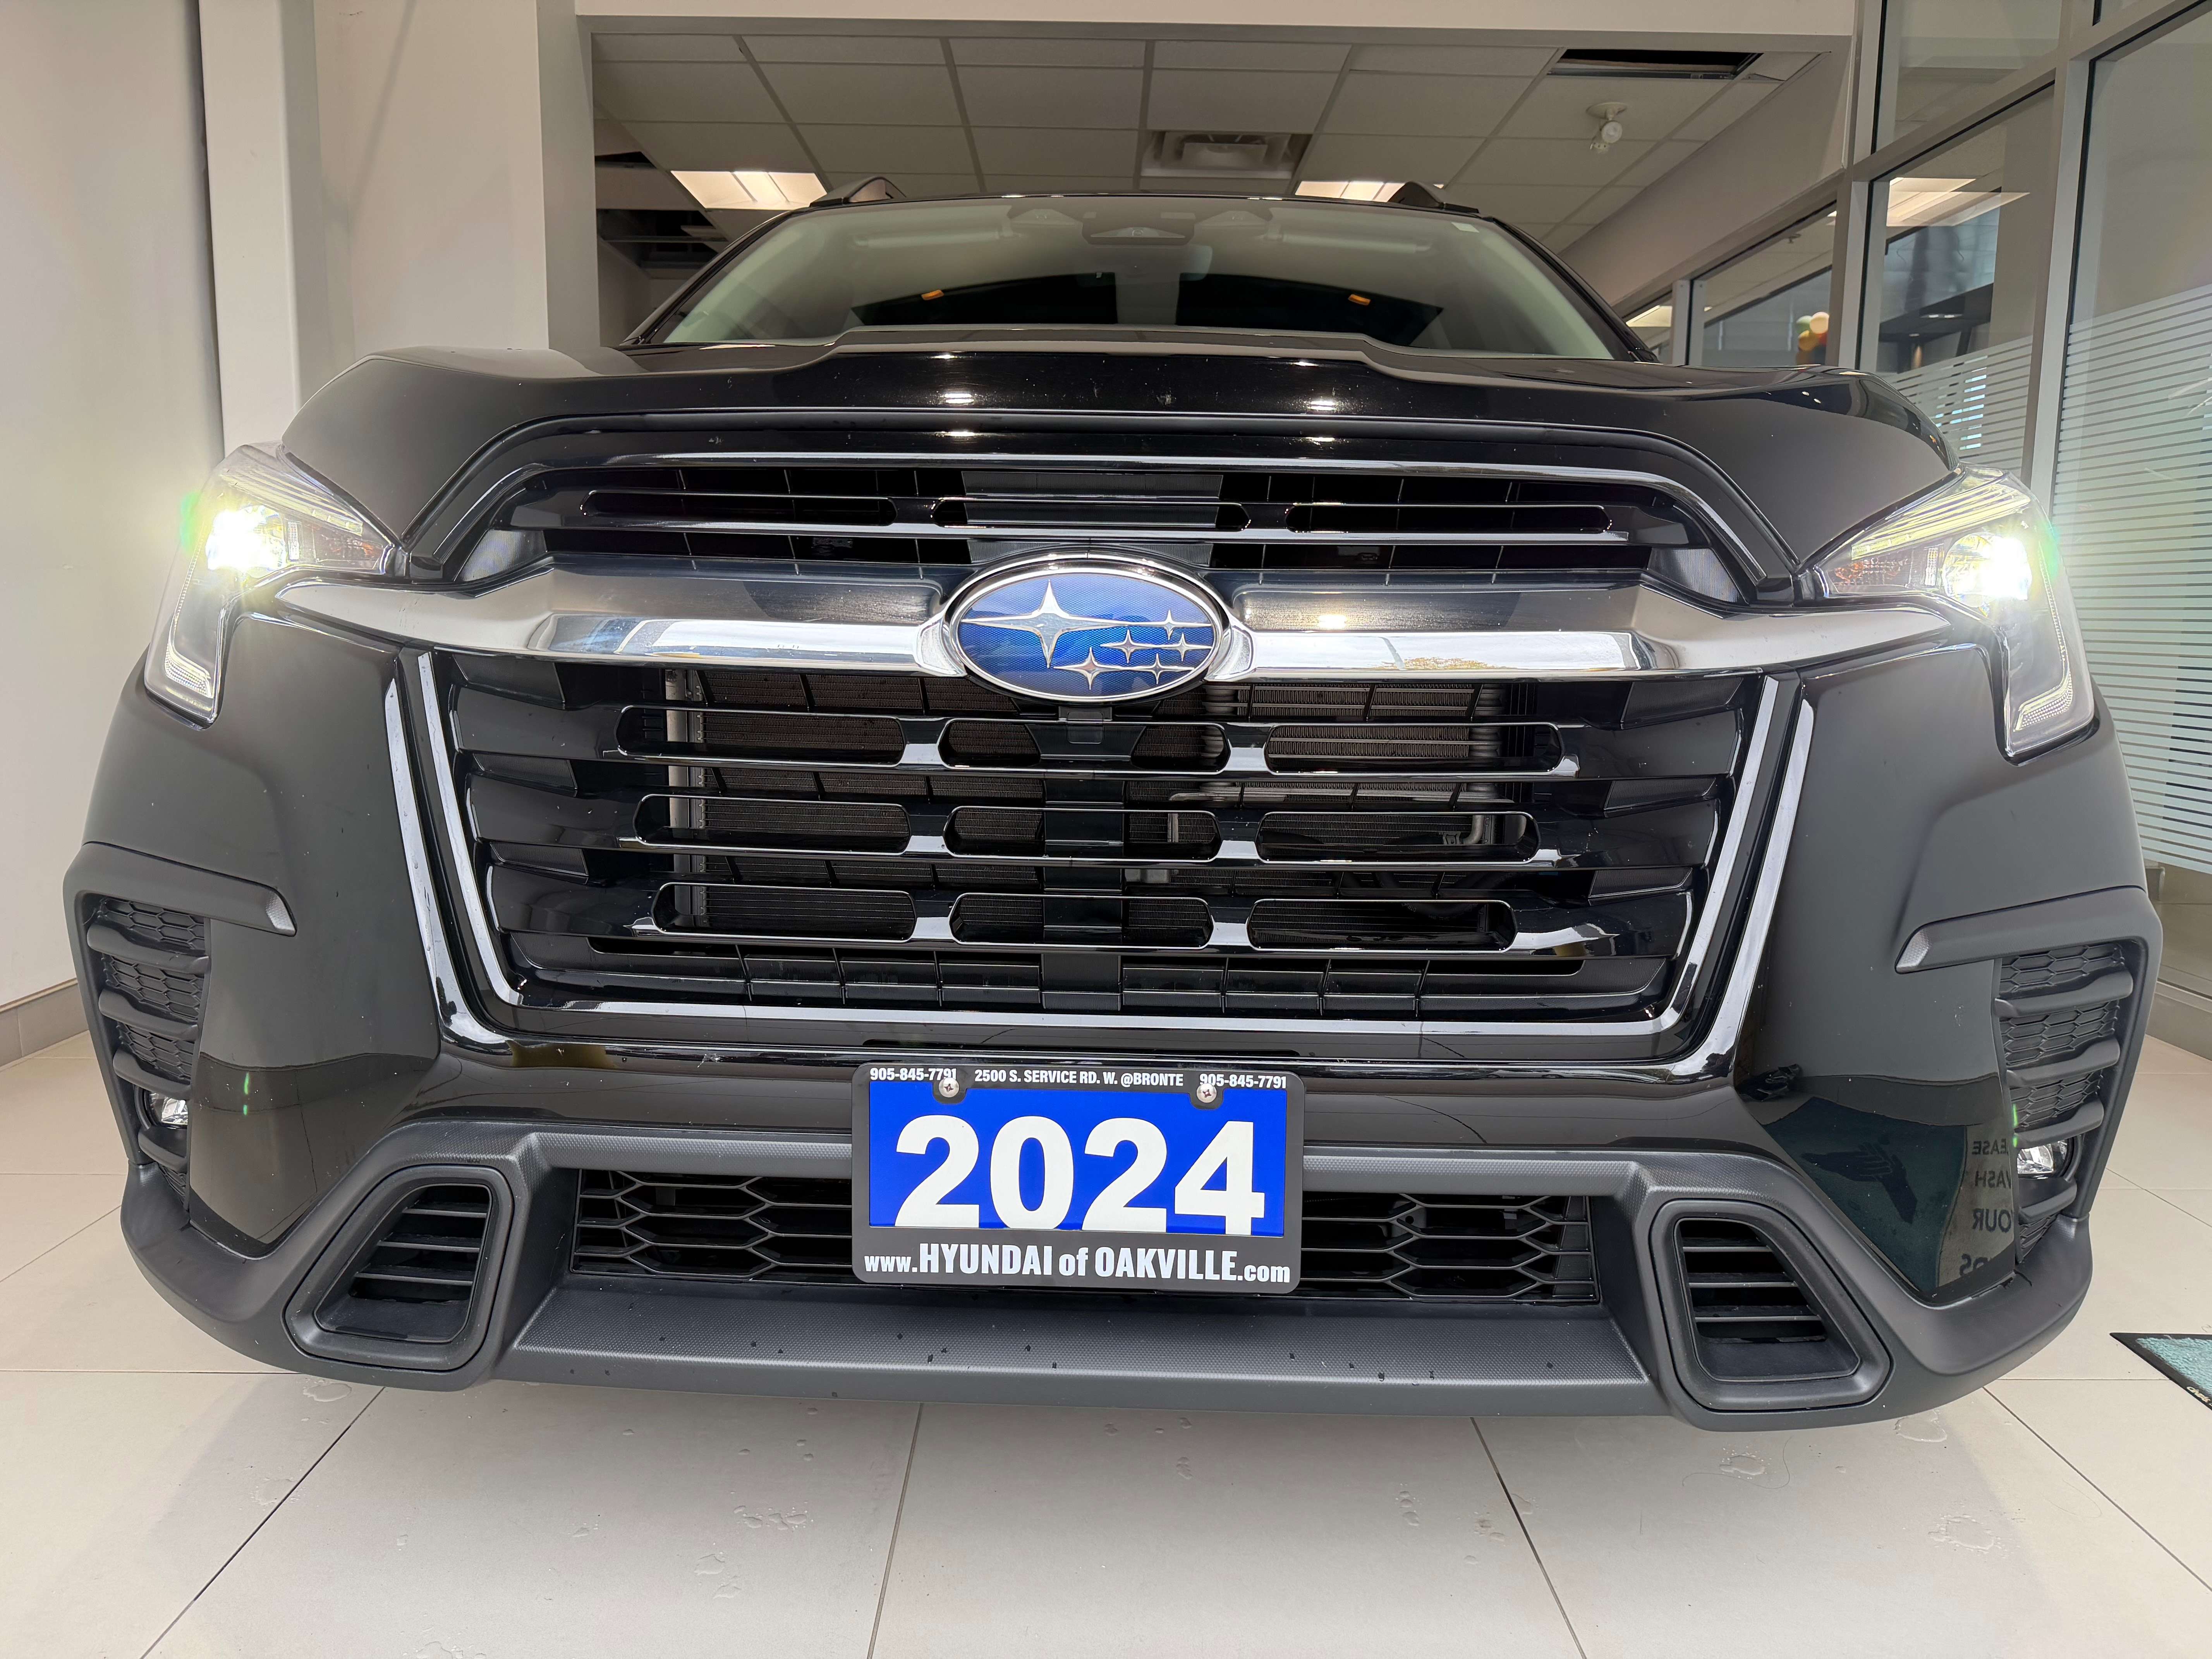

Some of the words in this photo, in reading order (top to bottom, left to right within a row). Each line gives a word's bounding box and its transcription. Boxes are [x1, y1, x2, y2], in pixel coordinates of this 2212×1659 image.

[870, 1067, 957, 1081] 905-845-7791
[975, 1069, 1006, 1082] 2500
[1009, 1070, 1021, 1083] S.
[1024, 1070, 1077, 1084] SERVICE
[1079, 1071, 1101, 1084] RD.
[1103, 1072, 1118, 1085] W.
[1121, 1072, 1184, 1087] @BRONTE
[1199, 1073, 1287, 1089] 905-845-7791
[895, 1114, 1265, 1236] 2024
[864, 1243, 1053, 1275] www.HYUNDAI
[1058, 1247, 1089, 1276] of
[1095, 1246, 1291, 1283] OAKVILLE.com
